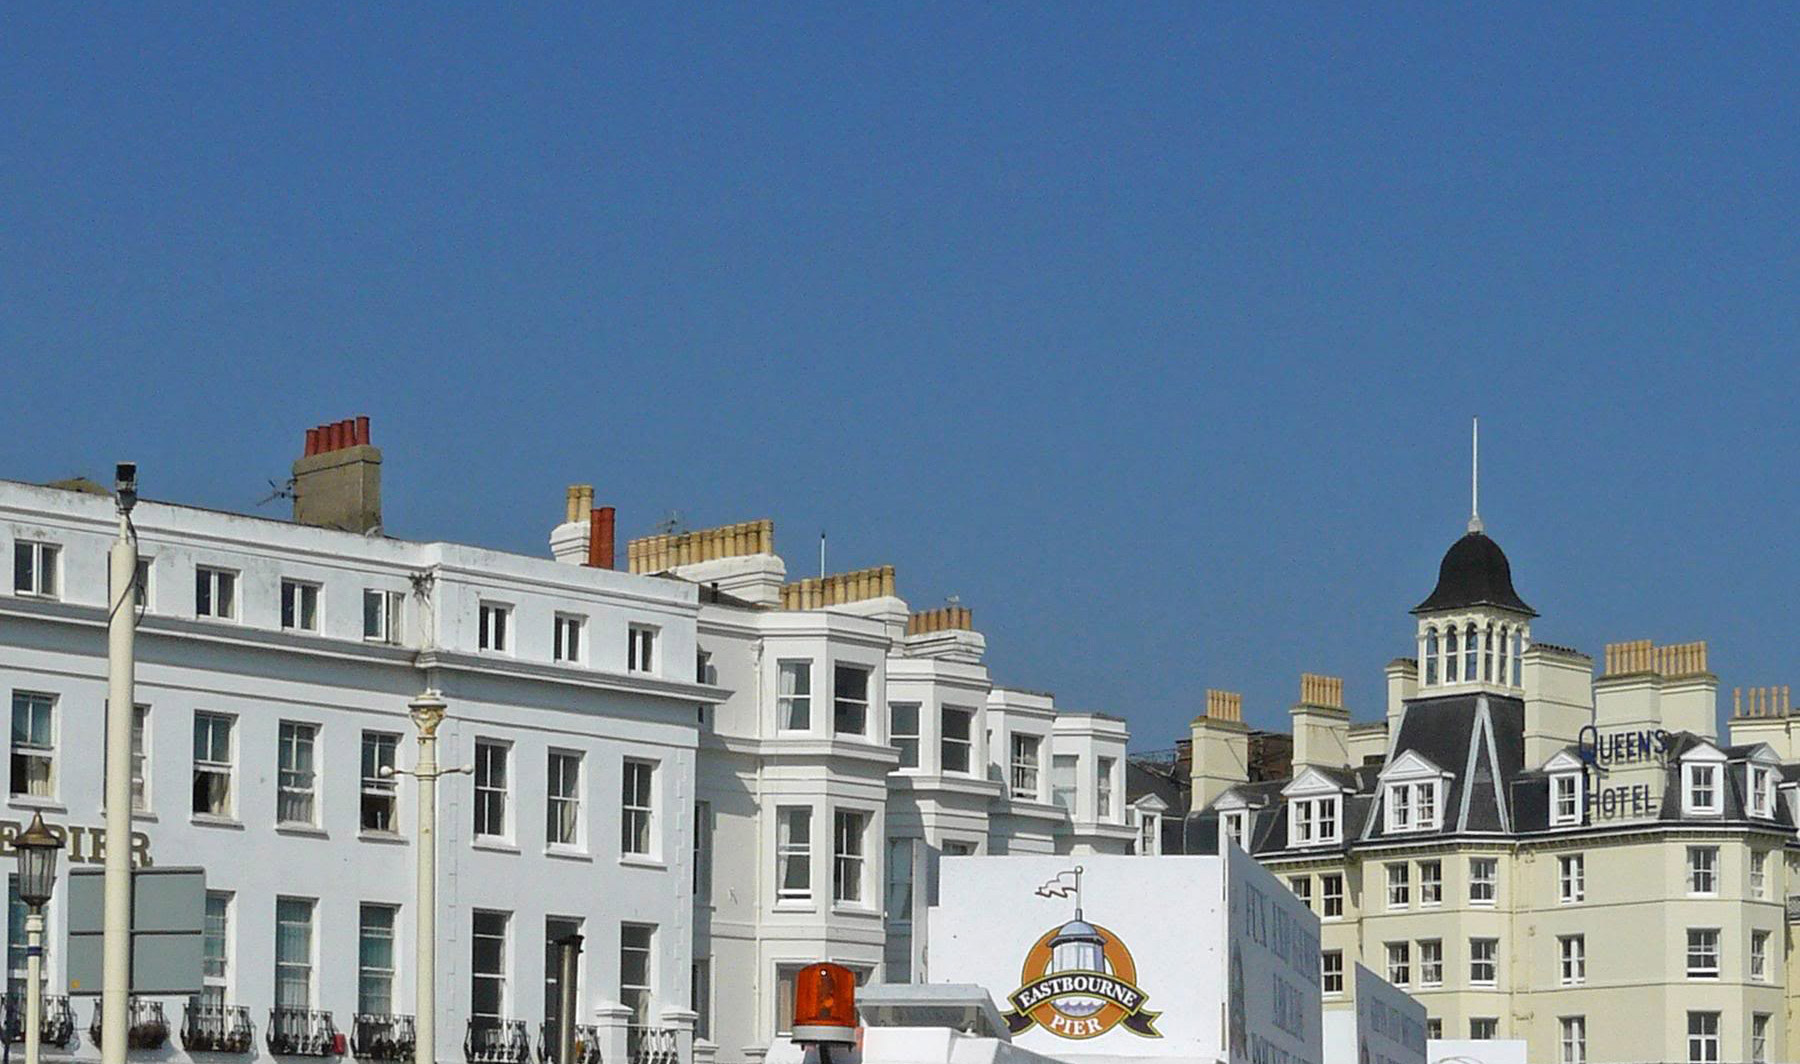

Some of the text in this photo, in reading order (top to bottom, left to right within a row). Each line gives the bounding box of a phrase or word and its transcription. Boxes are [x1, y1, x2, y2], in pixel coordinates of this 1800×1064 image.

[1579, 725, 1671, 771] QUEEN'S
[1583, 774, 1657, 818] HOTEL
[1017, 976, 1137, 1009] EASTBOURNE
[1050, 1014, 1103, 1036] PIER
